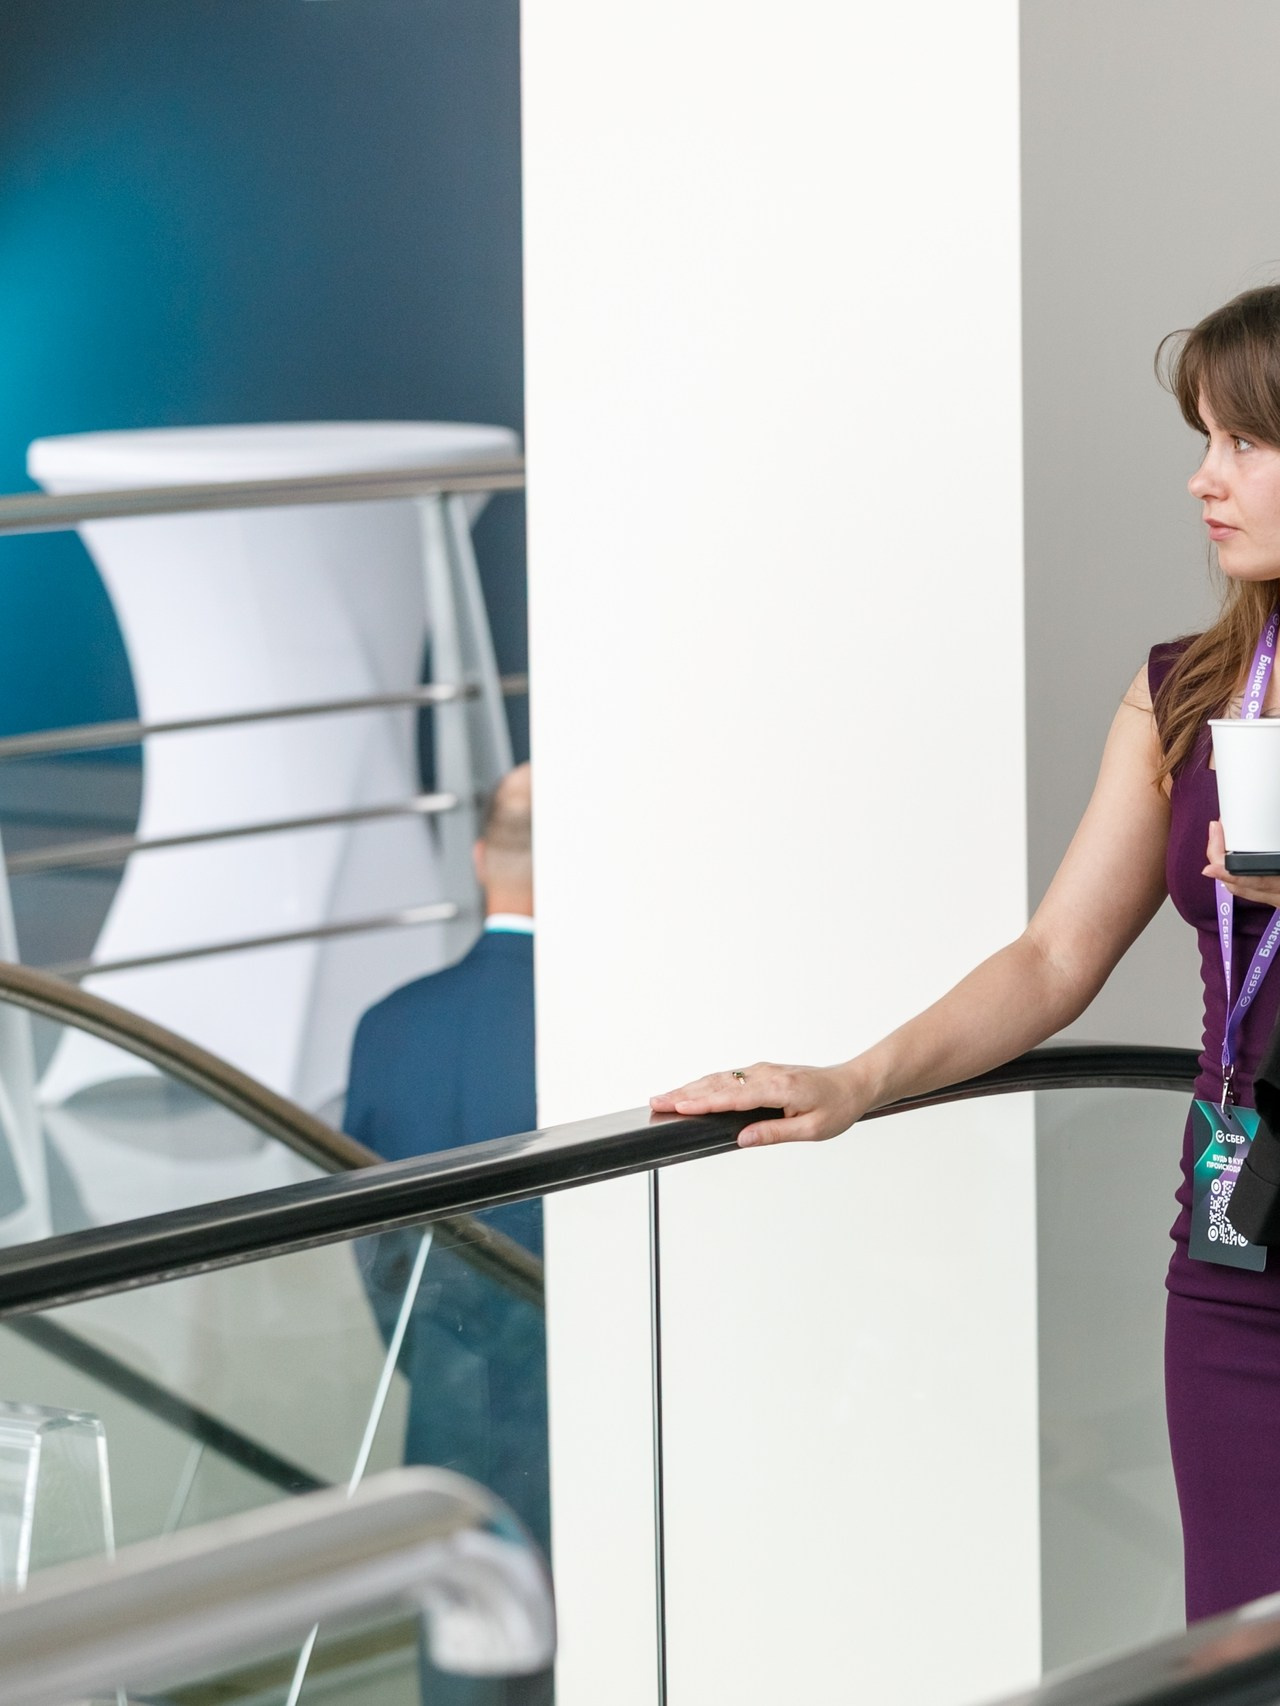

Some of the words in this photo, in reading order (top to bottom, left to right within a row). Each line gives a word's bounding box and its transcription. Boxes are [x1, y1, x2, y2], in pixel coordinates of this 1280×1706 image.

[1250, 653, 1272, 699] Бизнес
[1222, 917, 1230, 949] СБЕР
[1247, 965, 1262, 994] СБЕР
[1225, 1133, 1246, 1145] СБЕР
